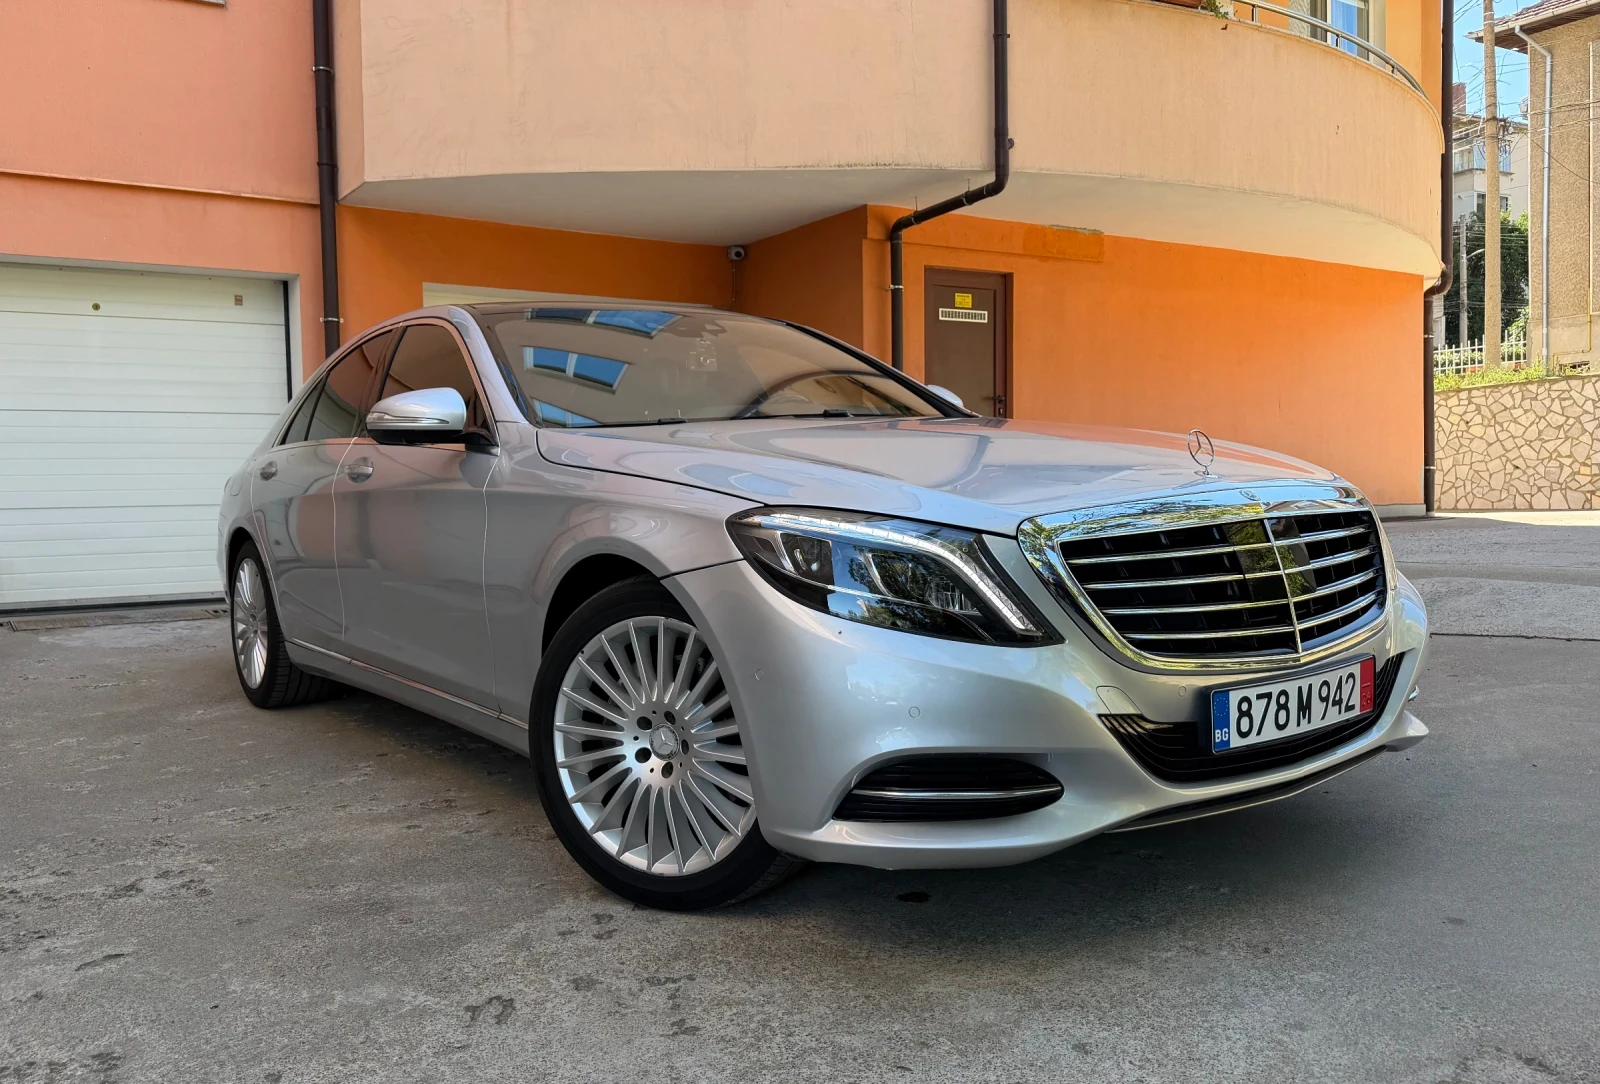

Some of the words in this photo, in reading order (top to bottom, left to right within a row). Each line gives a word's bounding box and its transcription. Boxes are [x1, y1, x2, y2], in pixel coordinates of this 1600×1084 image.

[1236, 689, 1290, 739] 878
[1296, 683, 1312, 727] M
[1318, 672, 1356, 721] 942
[1215, 728, 1229, 743] BG
